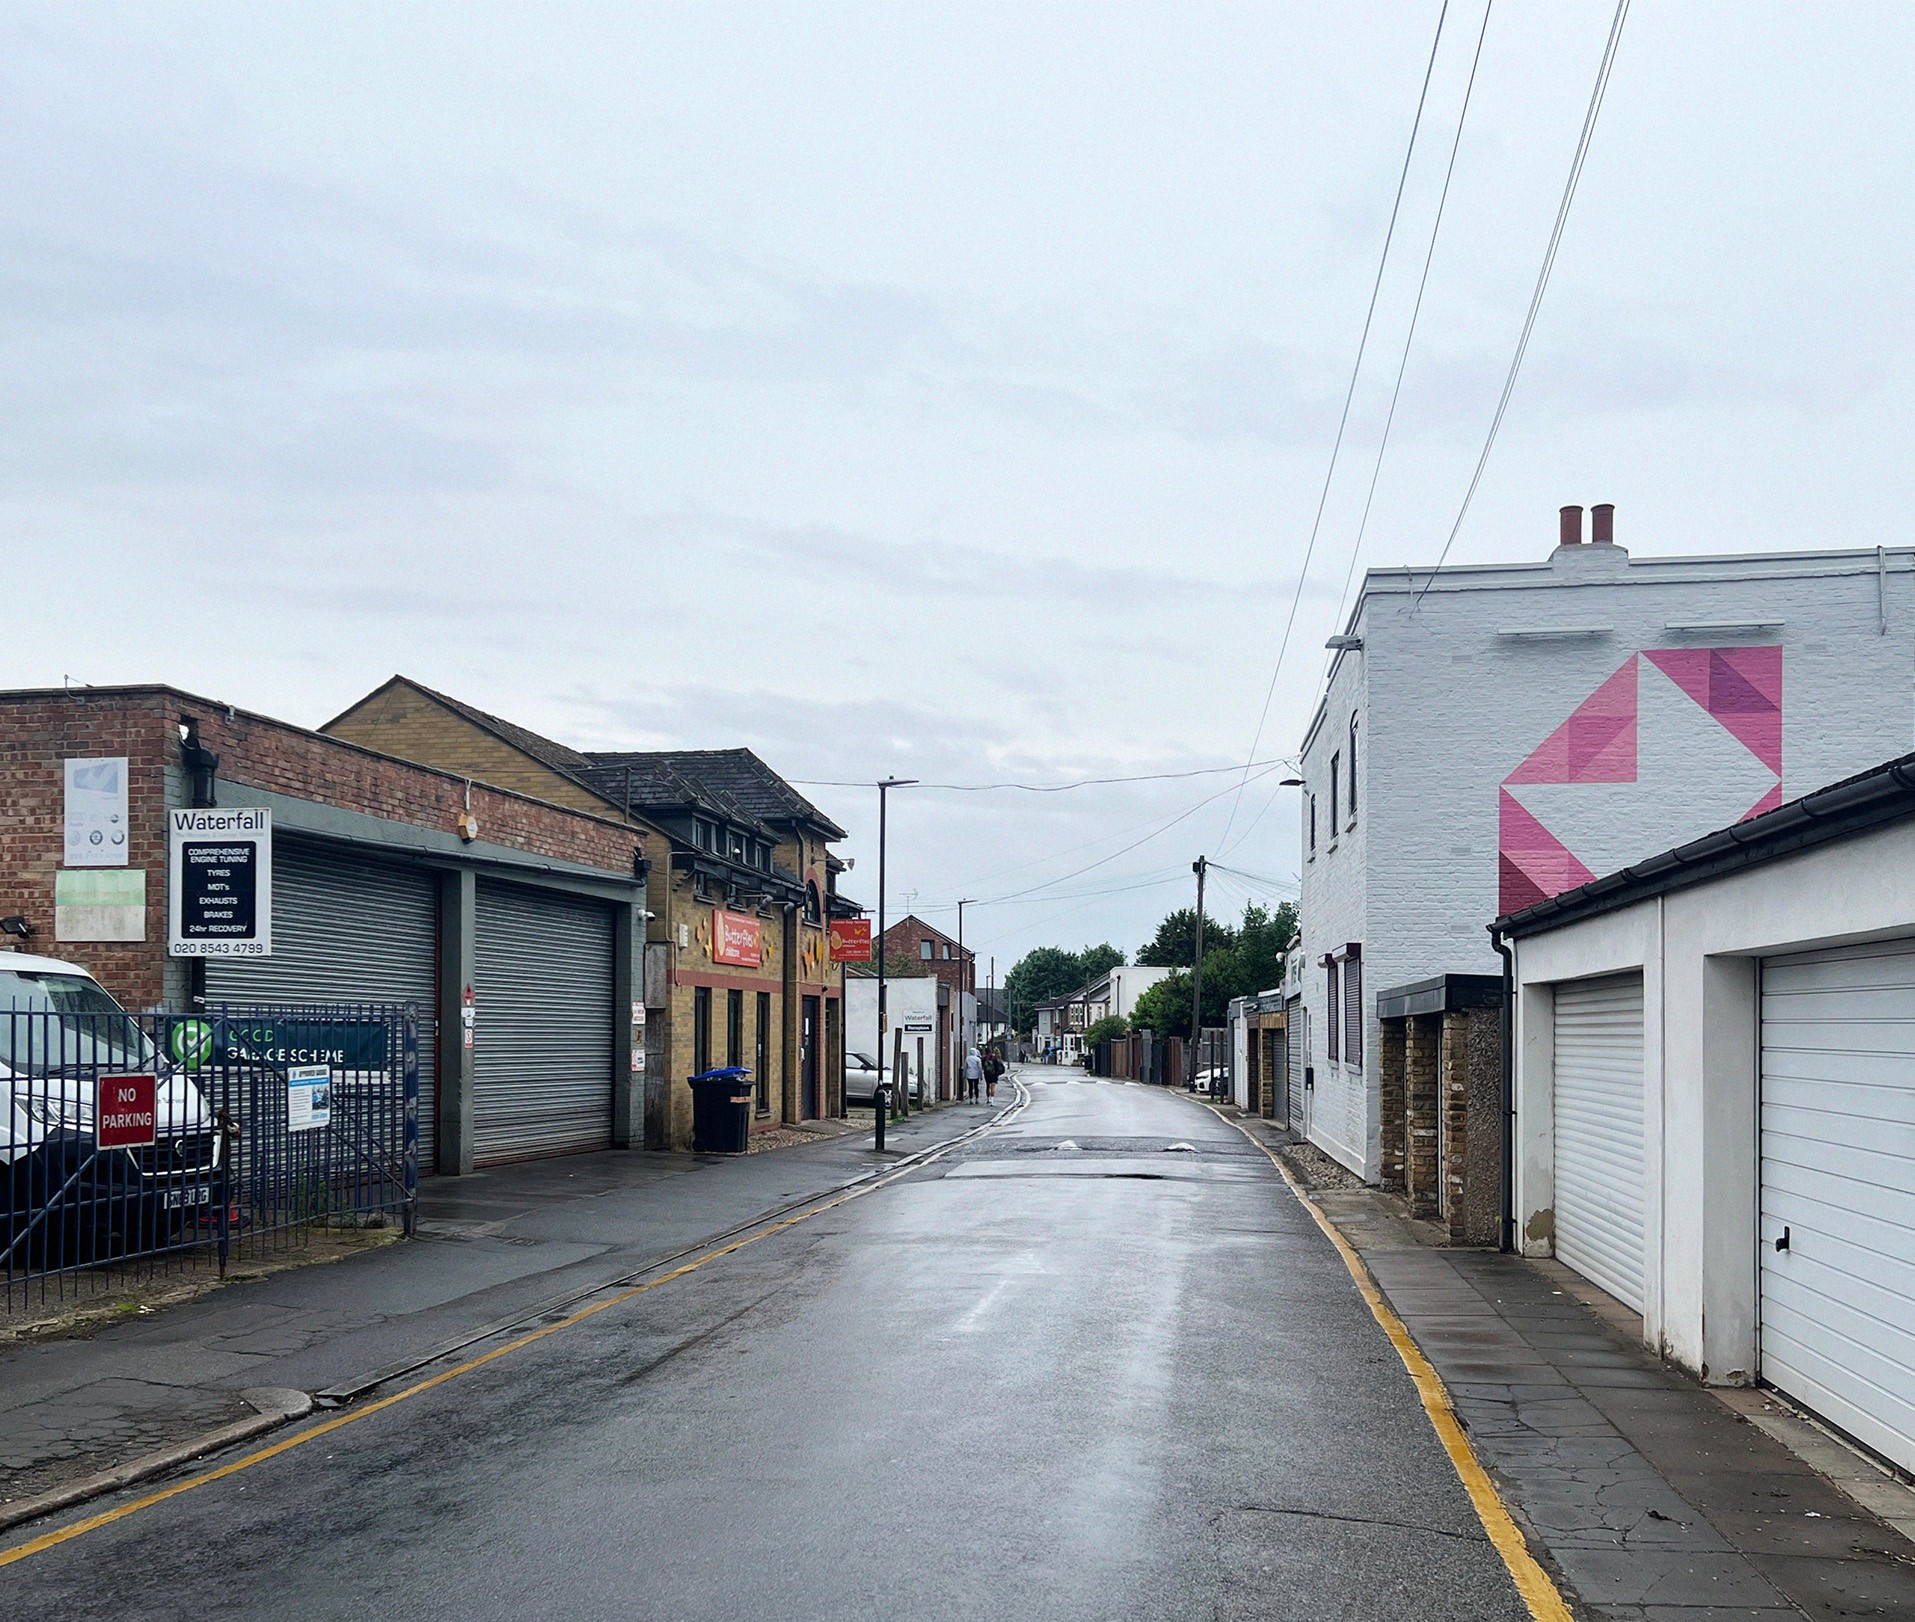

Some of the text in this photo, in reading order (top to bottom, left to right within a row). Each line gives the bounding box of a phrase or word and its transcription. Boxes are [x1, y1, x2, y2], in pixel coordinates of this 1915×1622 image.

[174, 811, 264, 831] Waterfall
[187, 847, 250, 856] COMPREHENSIVE
[190, 855, 248, 864] ENGINE TUNING
[206, 869, 231, 877] TYRES
[207, 883, 230, 891] MOT's
[198, 896, 238, 905] EXHAUSTS
[203, 910, 234, 919] BRAKES
[189, 924, 248, 933] 24hr RECOVERY
[725, 923, 754, 948] Butterflies
[174, 943, 264, 954] 020 8543 4799
[227, 1046, 286, 1062] GAGE
[117, 1087, 137, 1103] NO
[102, 1111, 153, 1129] PARKING
